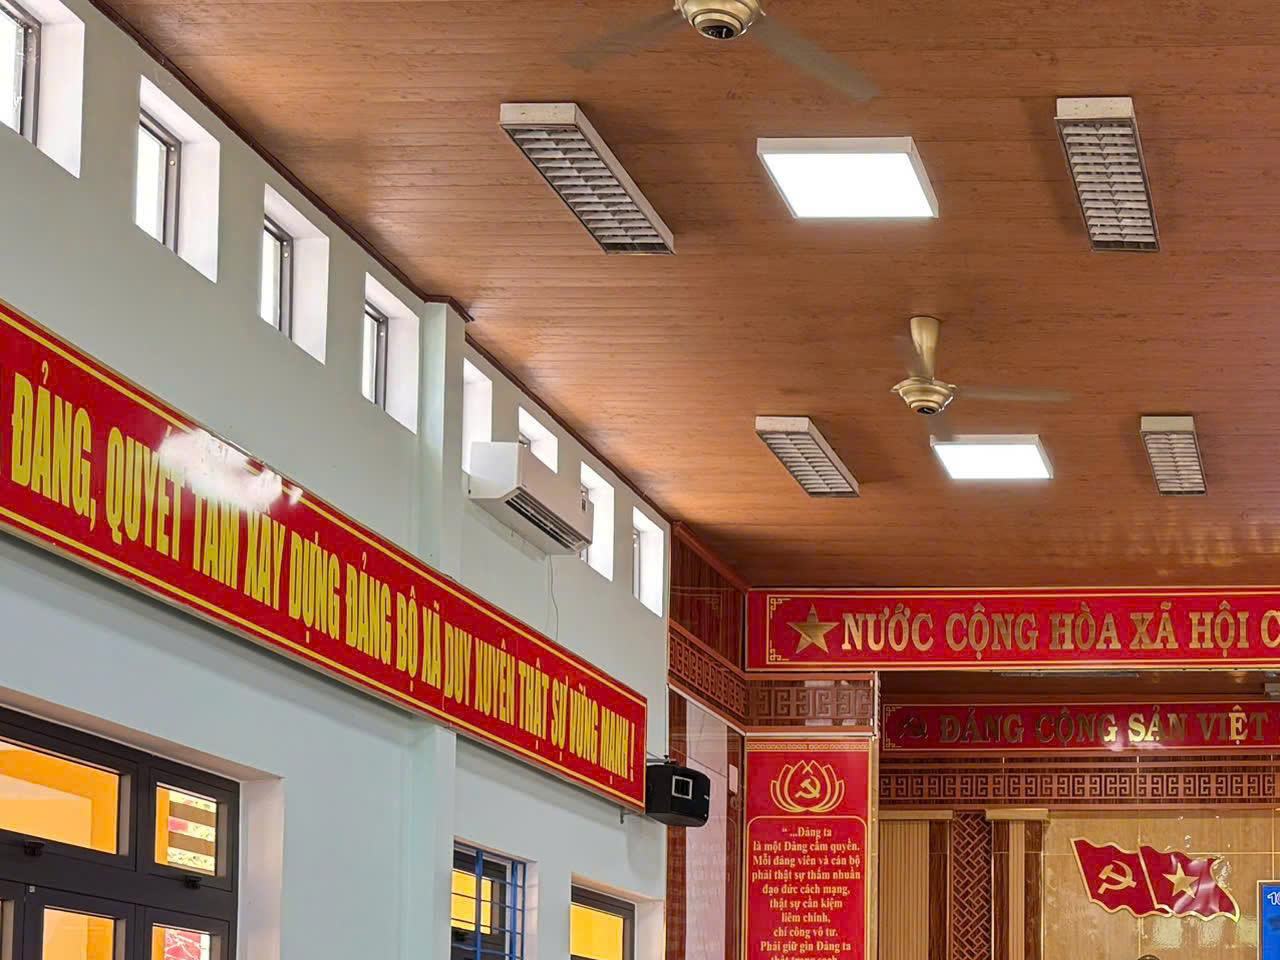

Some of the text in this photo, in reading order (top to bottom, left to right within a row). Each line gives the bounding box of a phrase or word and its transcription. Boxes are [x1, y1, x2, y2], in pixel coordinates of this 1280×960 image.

[12, 360, 96, 531] ĐẢNG,
[289, 531, 340, 644] DỰNG
[345, 551, 392, 665] ĐẢNG
[396, 585, 418, 692] BỘ
[421, 600, 441, 689] XÃ
[444, 621, 472, 707] DUY
[474, 638, 516, 726] XUYÊN
[518, 657, 549, 750] THẬT
[551, 675, 568, 761] SỰ
[569, 683, 598, 765] VỮNG
[841, 602, 935, 652] NƯỚC
[945, 602, 1037, 660] CỘNG
[1048, 602, 1122, 651] HÒA
[1128, 602, 1177, 651] XÃ
[1189, 600, 1250, 658] HỘI
[940, 707, 1024, 744] ĐẢNG
[1035, 707, 1118, 746] CỘNG
[1128, 705, 1187, 744] SẢN
[1198, 704, 1269, 746] VIỆT
